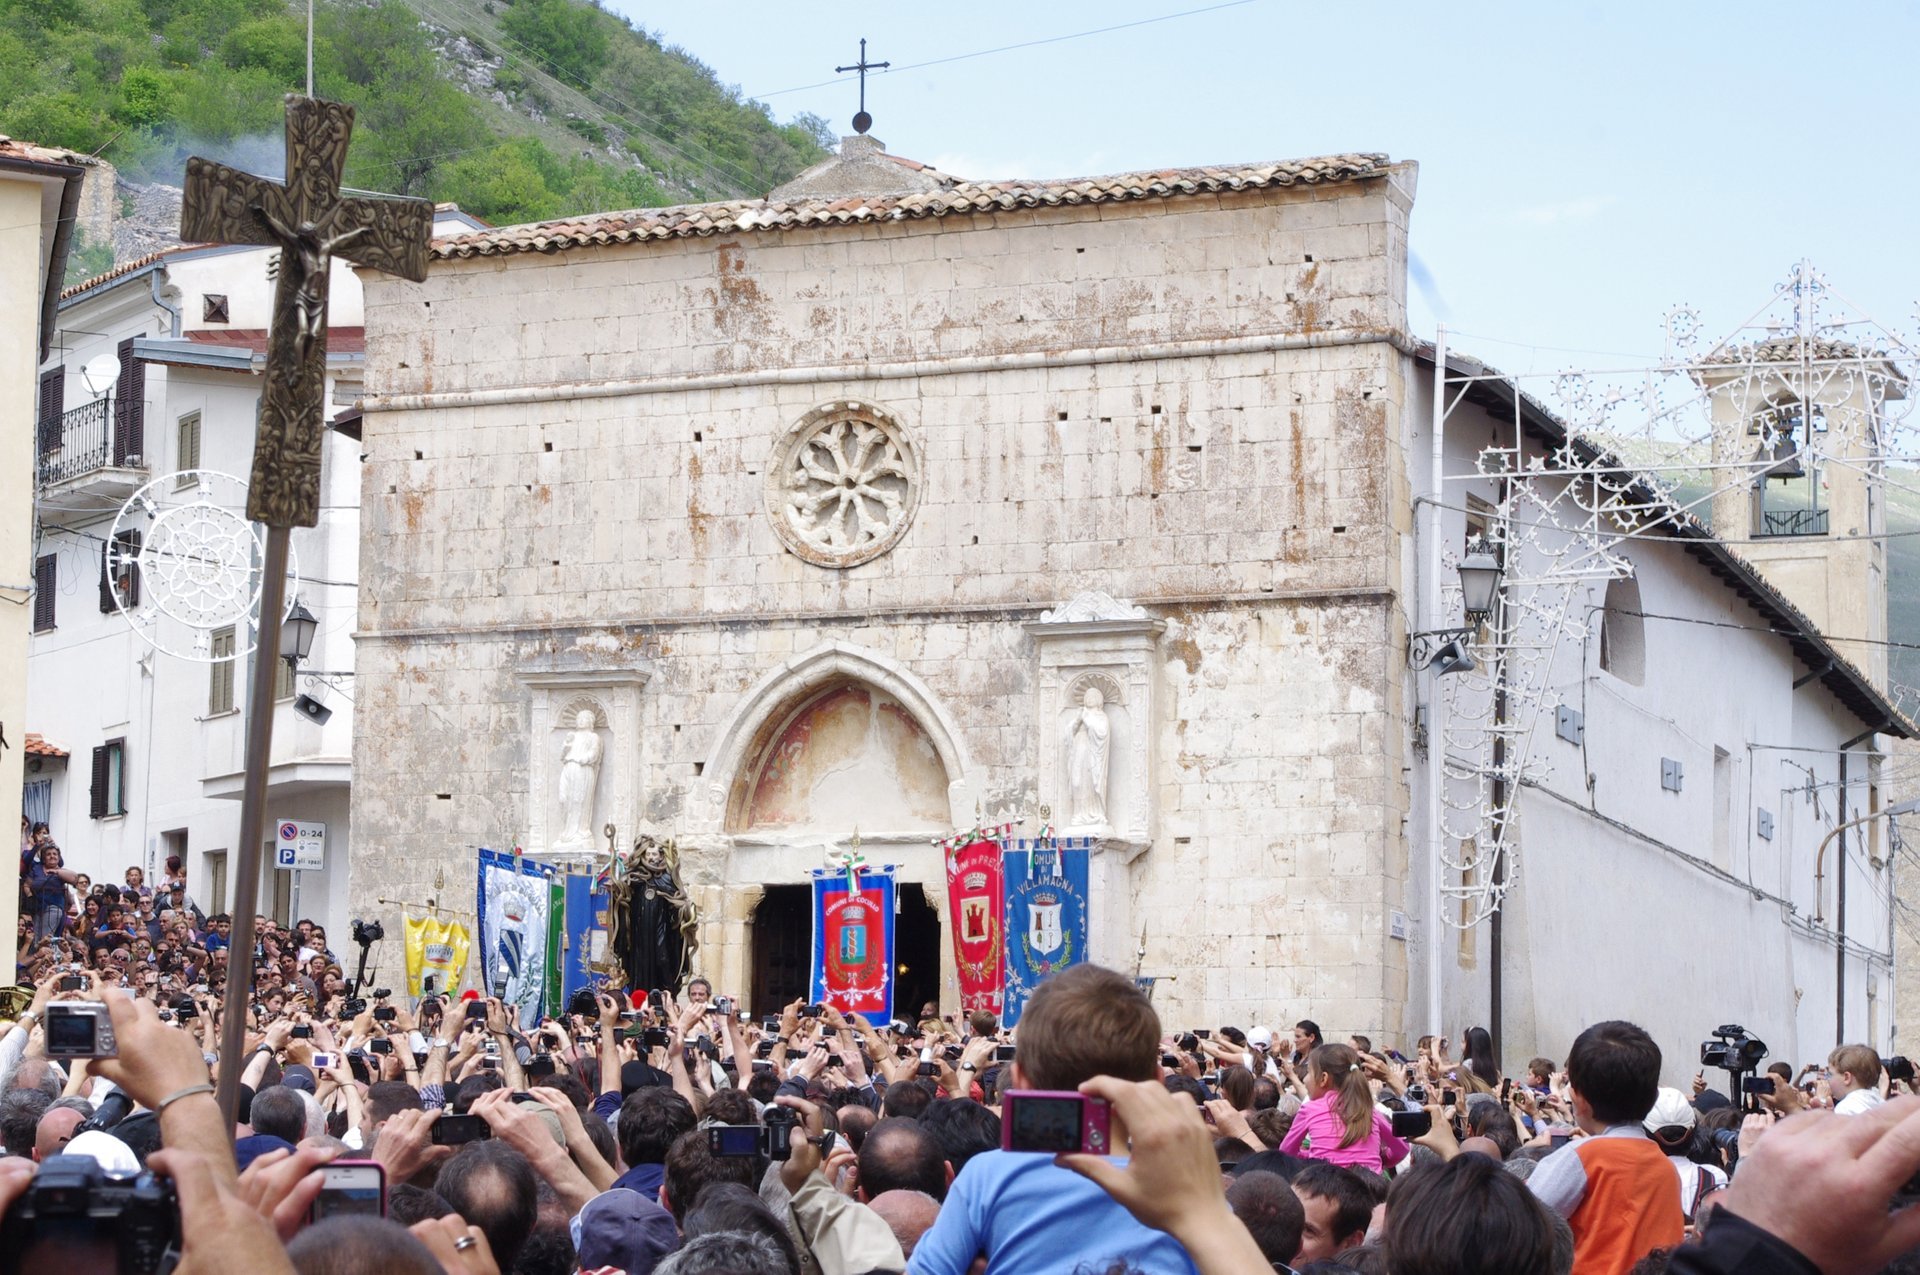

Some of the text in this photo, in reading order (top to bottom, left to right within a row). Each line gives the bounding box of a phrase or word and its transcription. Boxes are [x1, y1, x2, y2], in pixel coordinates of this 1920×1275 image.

[1033, 853, 1057, 866] OMUN
[1016, 874, 1075, 896] VILLAMAGNA
[826, 898, 847, 916] COMUNE
[857, 897, 879, 912] COCULLO
